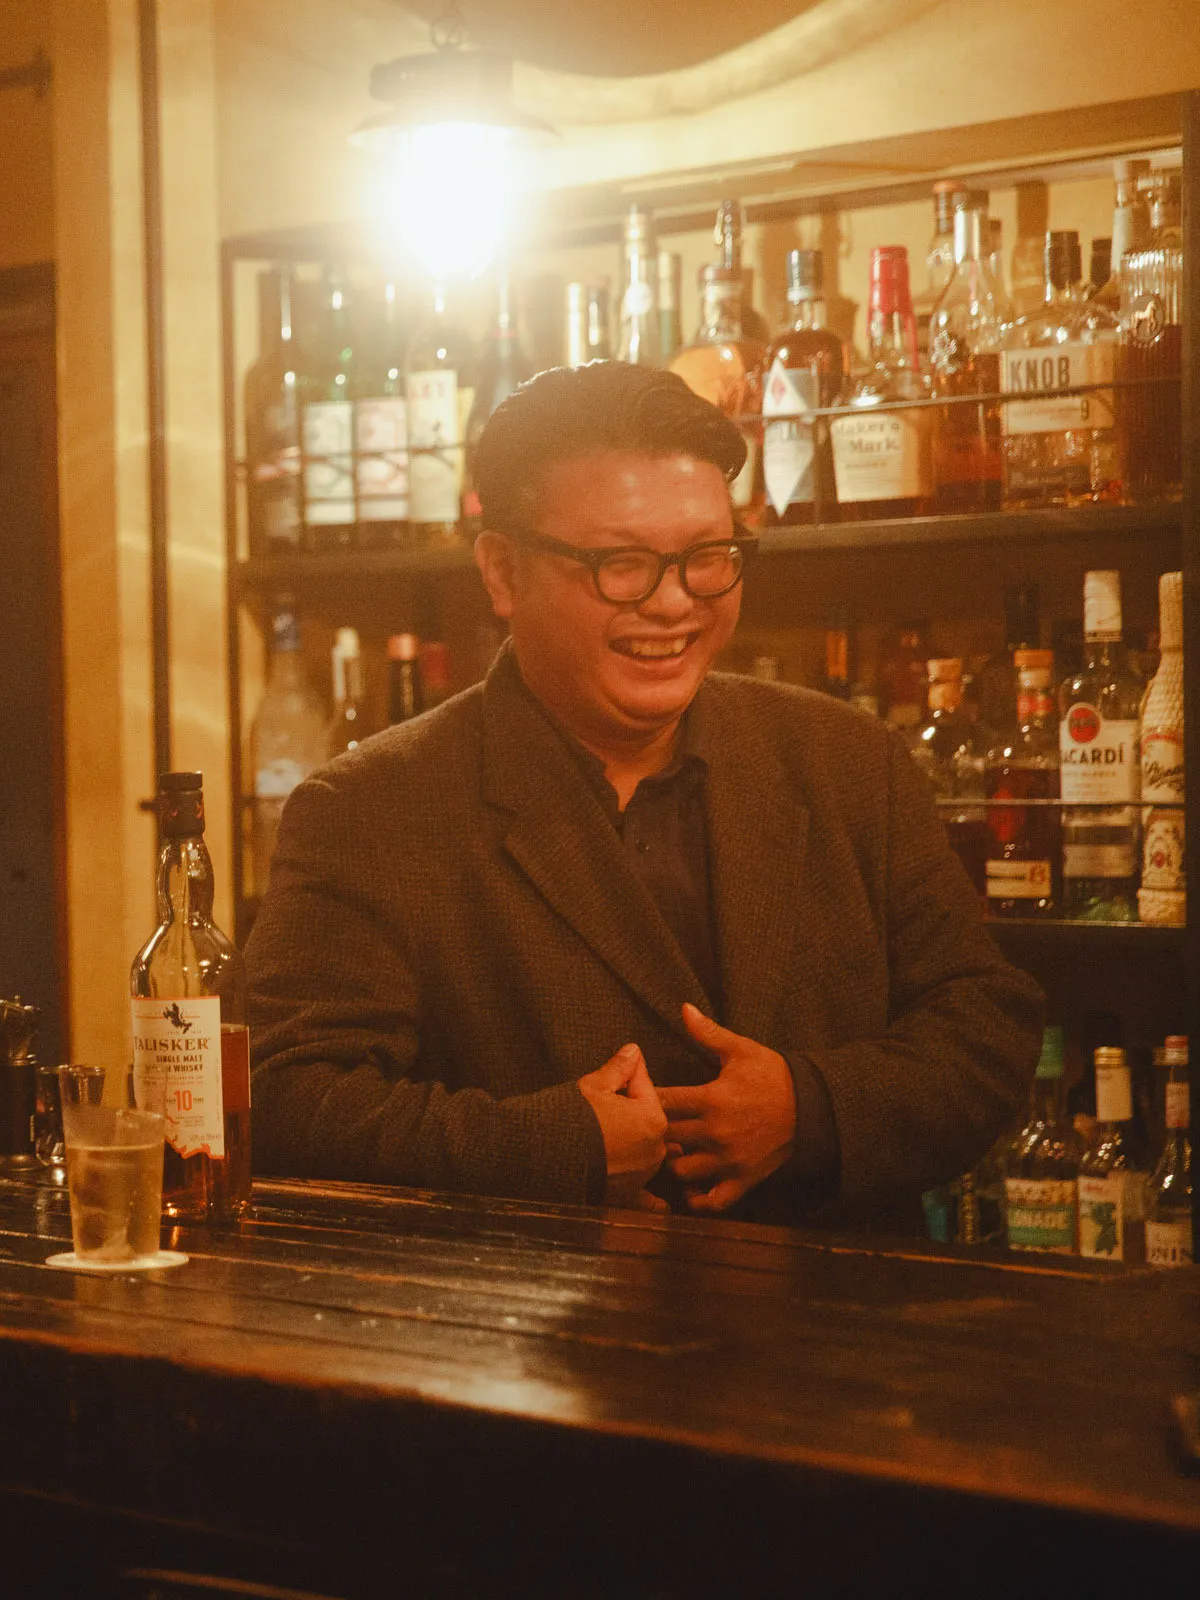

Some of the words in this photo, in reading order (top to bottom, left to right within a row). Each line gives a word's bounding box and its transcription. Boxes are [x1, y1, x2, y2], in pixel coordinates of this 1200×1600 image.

[1010, 356, 1070, 392] KNOB
[133, 1036, 209, 1052] TALISKER
[155, 1054, 180, 1063] SINGLE
[183, 1054, 204, 1063] MALT
[173, 1063, 204, 1073] WHISKY
[173, 1089, 193, 1112] 10
